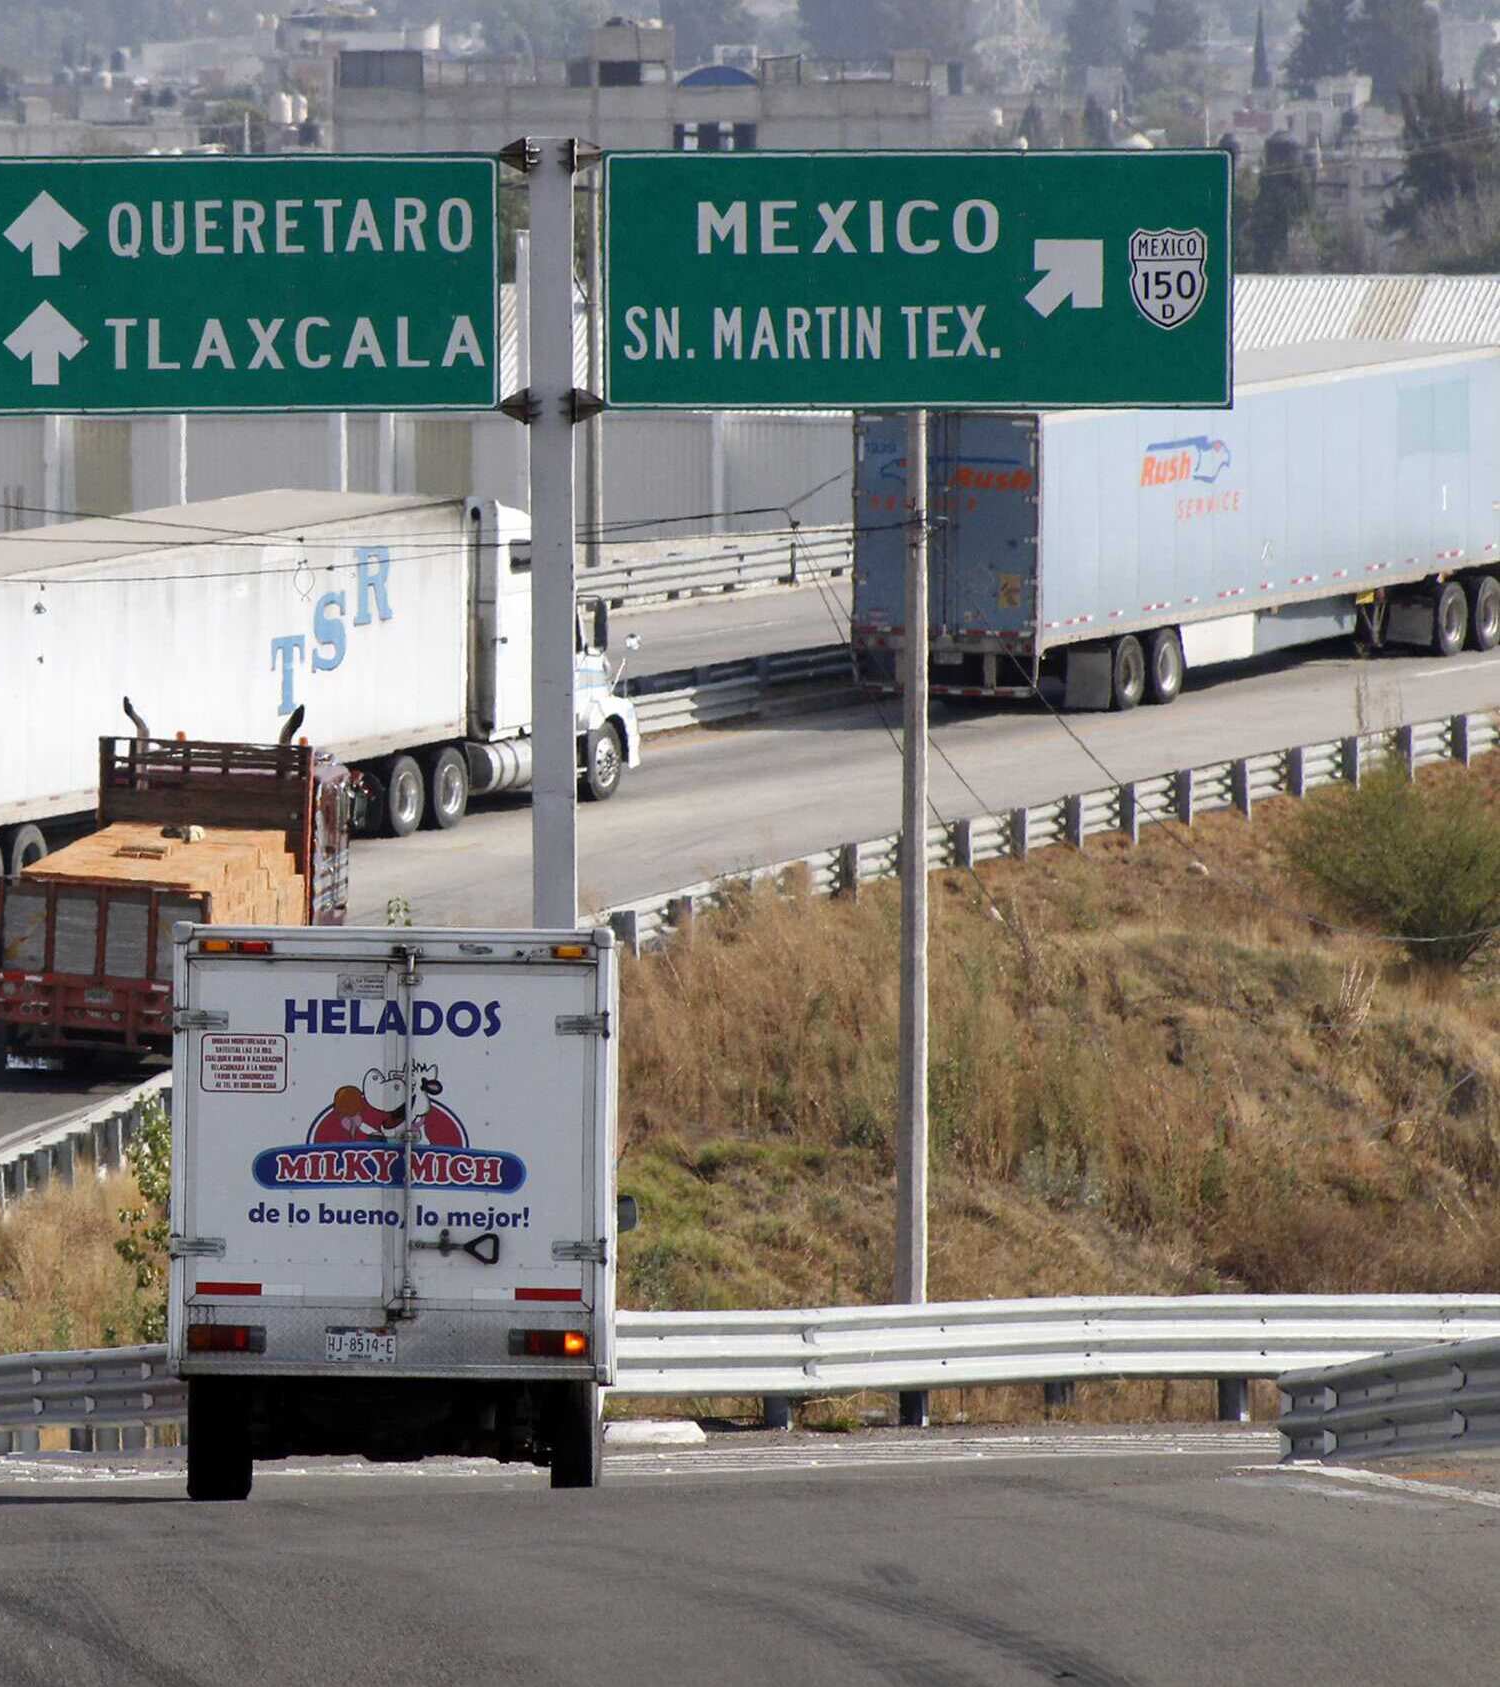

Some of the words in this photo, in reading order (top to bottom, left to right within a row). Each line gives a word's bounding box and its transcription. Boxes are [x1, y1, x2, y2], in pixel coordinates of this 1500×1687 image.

[108, 198, 474, 259] QUERETARO
[697, 199, 1000, 255] MEXICO
[1137, 236, 1198, 259] MEXICO
[1141, 270, 1197, 302] 150
[1161, 303, 1175, 321] D
[105, 316, 485, 370] TLAXCALA
[624, 306, 695, 361] SN.
[713, 306, 882, 360] MARTIN
[900, 305, 1001, 360] TEX.
[1139, 450, 1192, 487] Rush
[284, 998, 501, 1038] HELADOS
[277, 1151, 399, 1183] MILKY
[406, 1153, 503, 1185] MICH
[247, 1203, 281, 1225] de
[287, 1203, 311, 1225] lo
[416, 1206, 440, 1227] lo
[446, 1207, 530, 1231] mejor!
